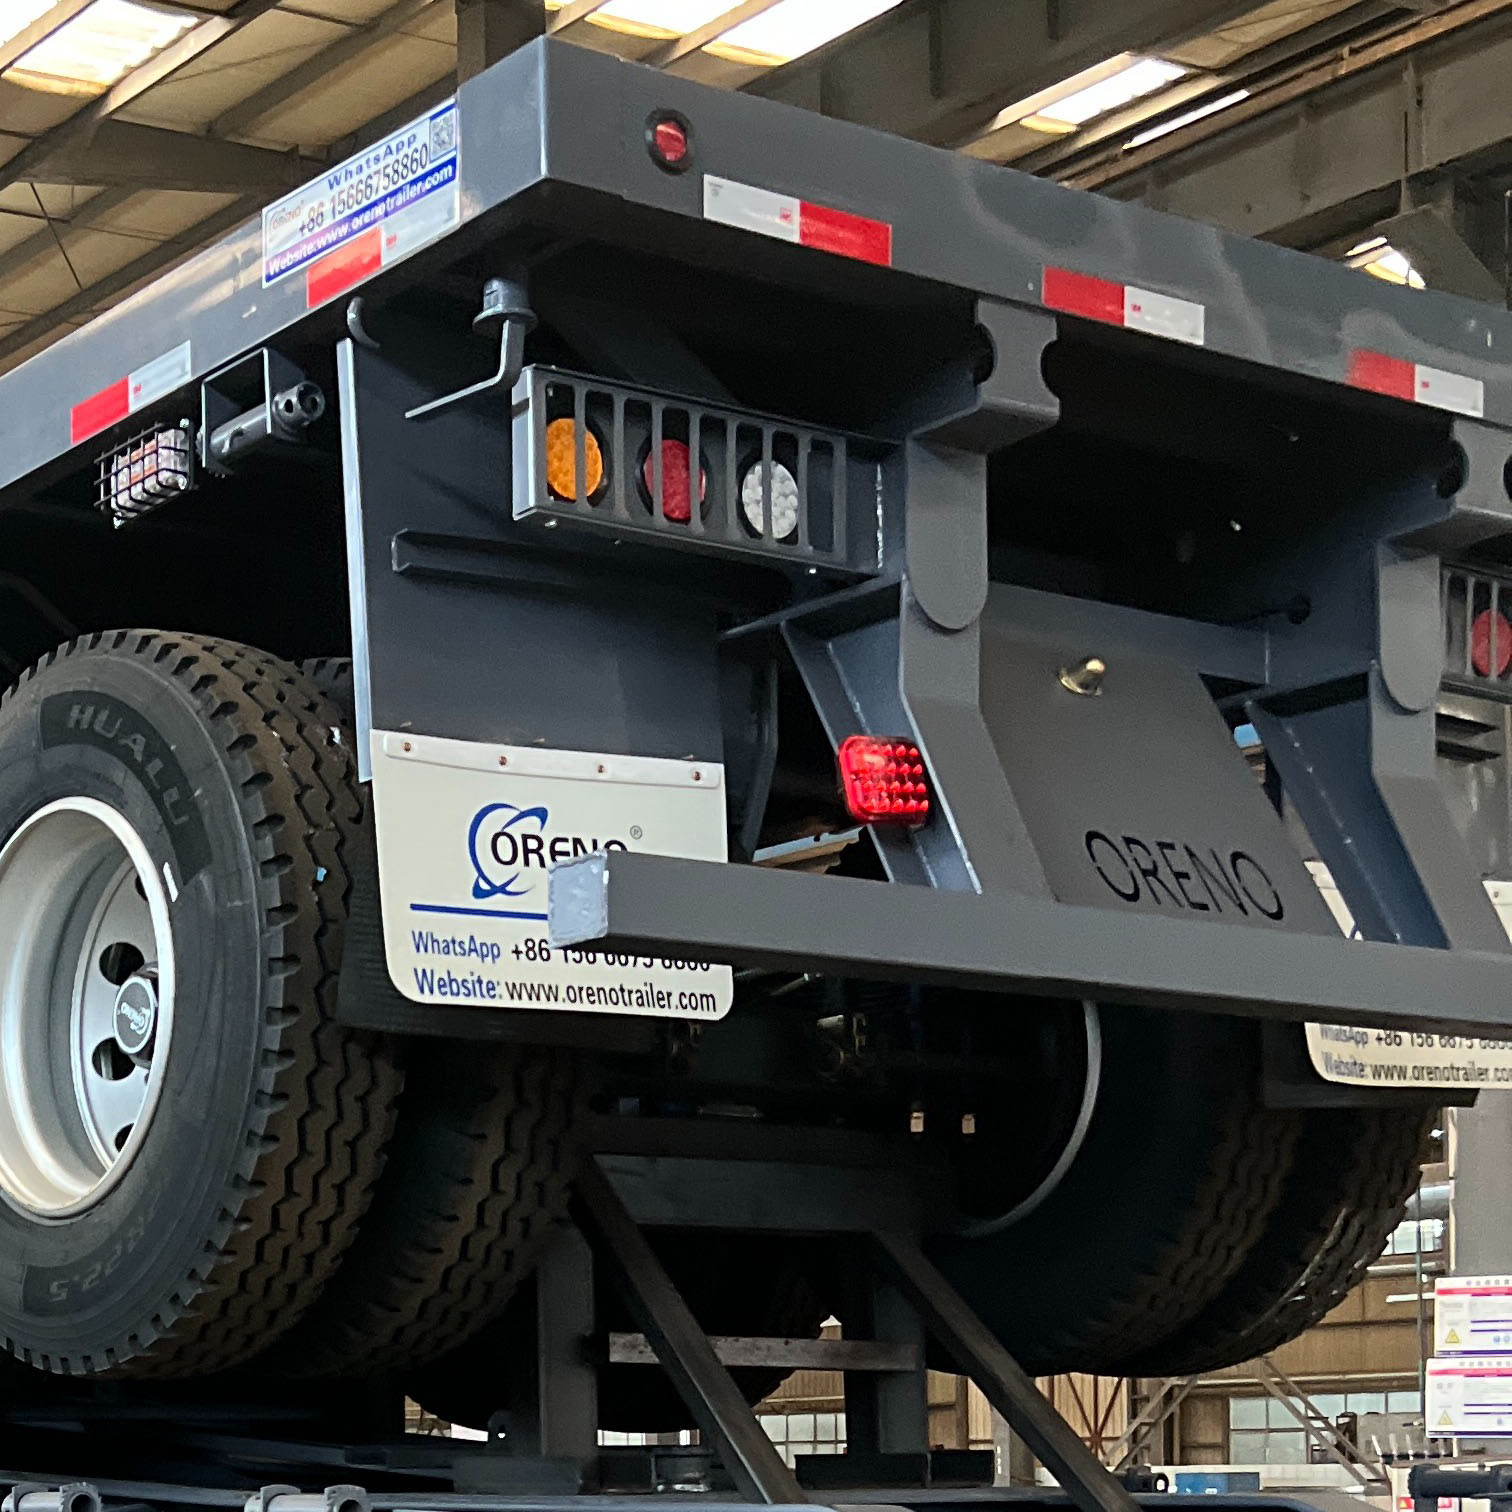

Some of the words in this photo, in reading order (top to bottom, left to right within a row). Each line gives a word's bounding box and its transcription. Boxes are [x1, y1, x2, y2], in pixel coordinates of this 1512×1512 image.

[327, 133, 417, 191] WhatsApp
[330, 143, 429, 221] 15666758860
[67, 704, 190, 826] HUALU
[1084, 830, 1285, 921] ORENO
[411, 930, 501, 964] WhatsApp
[511, 937, 551, 962] +86
[414, 967, 503, 1000] Website:
[505, 980, 717, 1012] www.orenotrailer.com
[1371, 1061, 1512, 1082] www.orenotrailer.co
